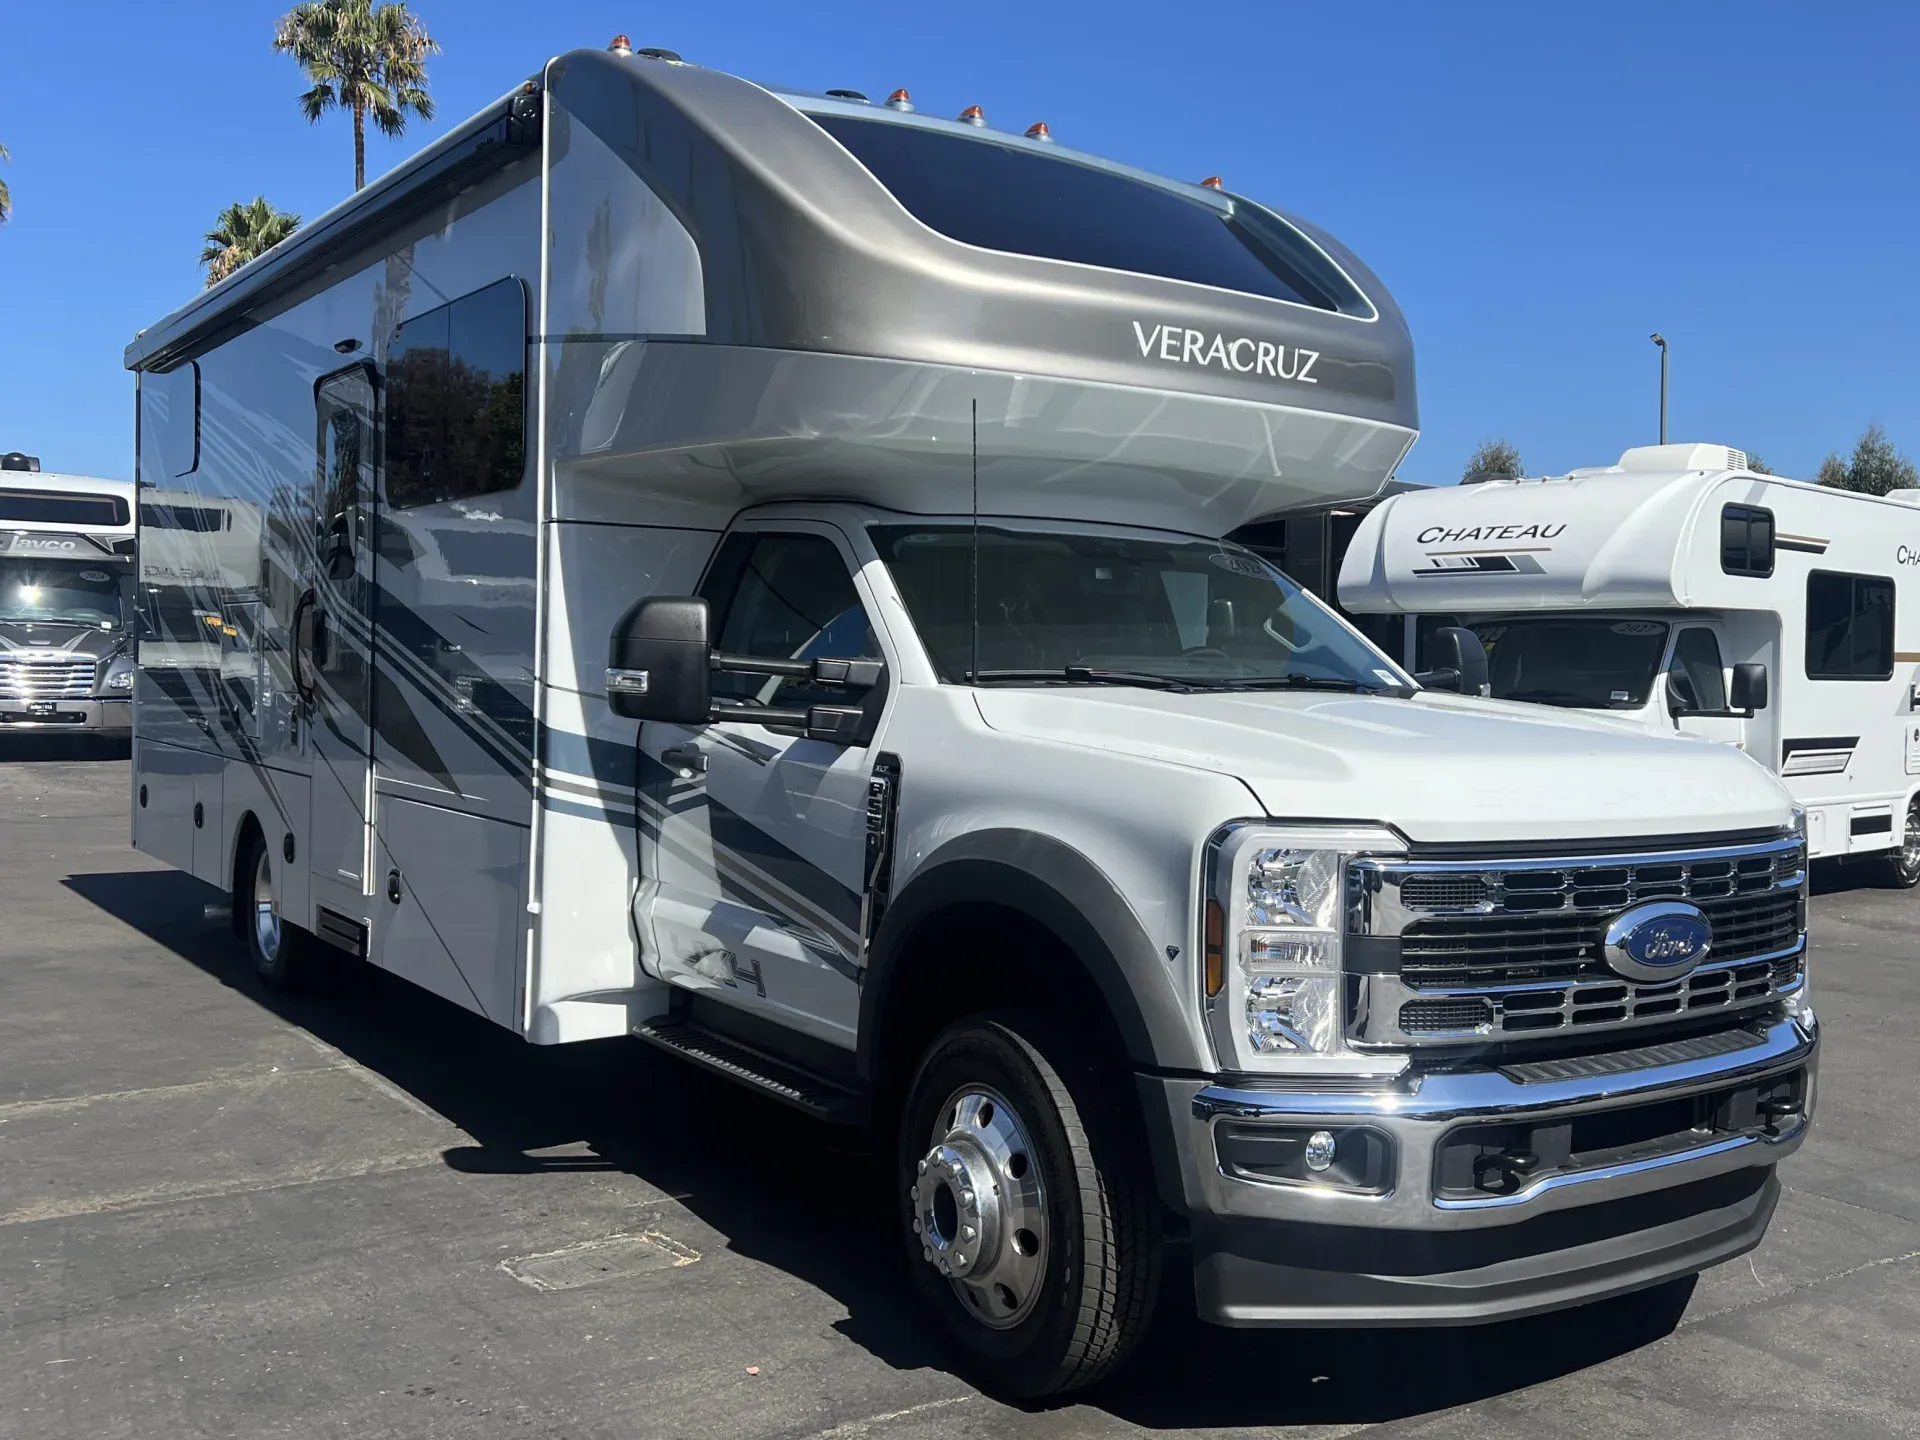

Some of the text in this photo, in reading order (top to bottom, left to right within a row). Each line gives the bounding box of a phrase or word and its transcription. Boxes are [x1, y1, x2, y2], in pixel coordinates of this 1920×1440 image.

[1132, 321, 1320, 383] VERACRUZ
[1416, 524, 1567, 544] CHATEAU
[875, 764, 889, 773] XLT
[1644, 930, 1694, 959] Ford
